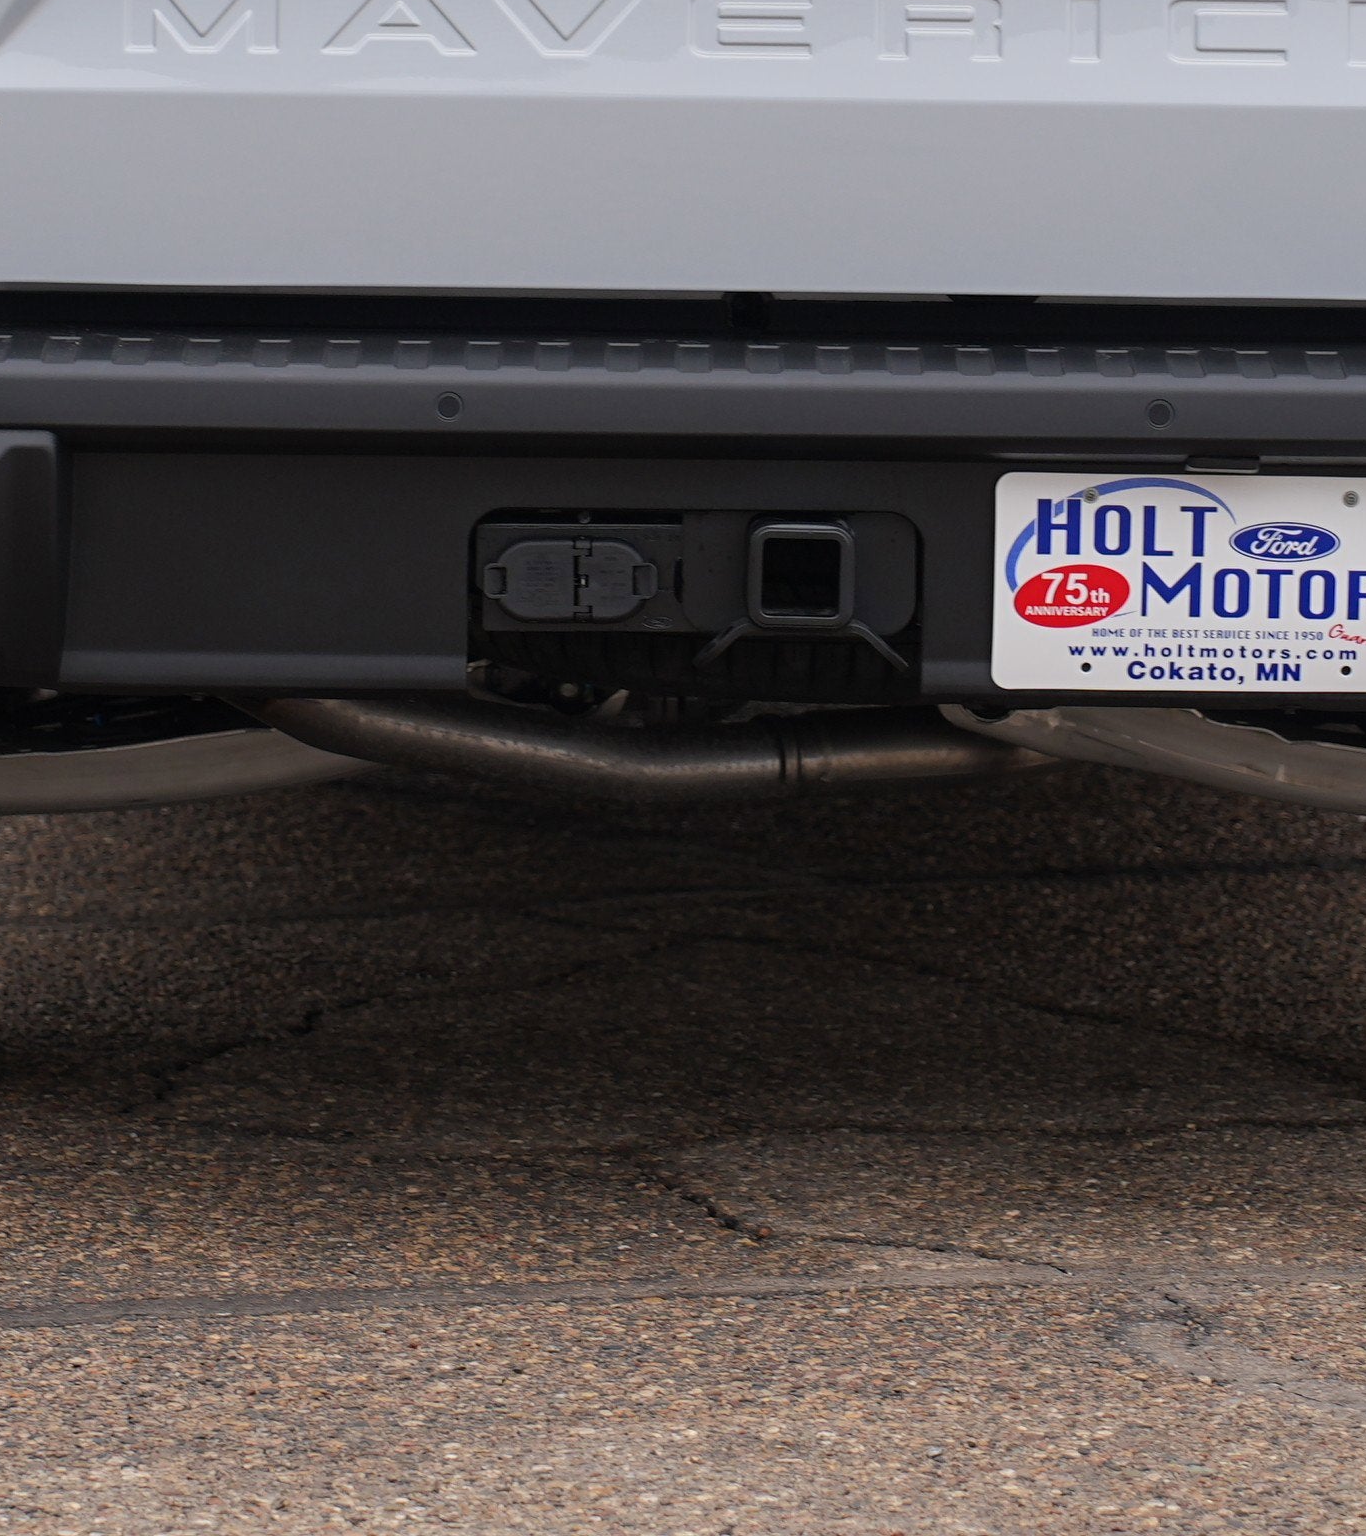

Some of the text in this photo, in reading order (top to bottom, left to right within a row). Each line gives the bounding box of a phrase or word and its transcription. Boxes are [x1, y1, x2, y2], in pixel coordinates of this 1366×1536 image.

[1037, 498, 1218, 557] HOLT
[1250, 527, 1319, 556] Ford
[1041, 572, 1110, 605] 75th
[1025, 605, 1109, 616] ANNIVERSARY
[1092, 628, 1324, 640] HOME OF THE BEST SERVICE SINCE 1950
[1069, 644, 1357, 660] www.holtmotors.com
[1127, 661, 1301, 684] Cokato, MN
